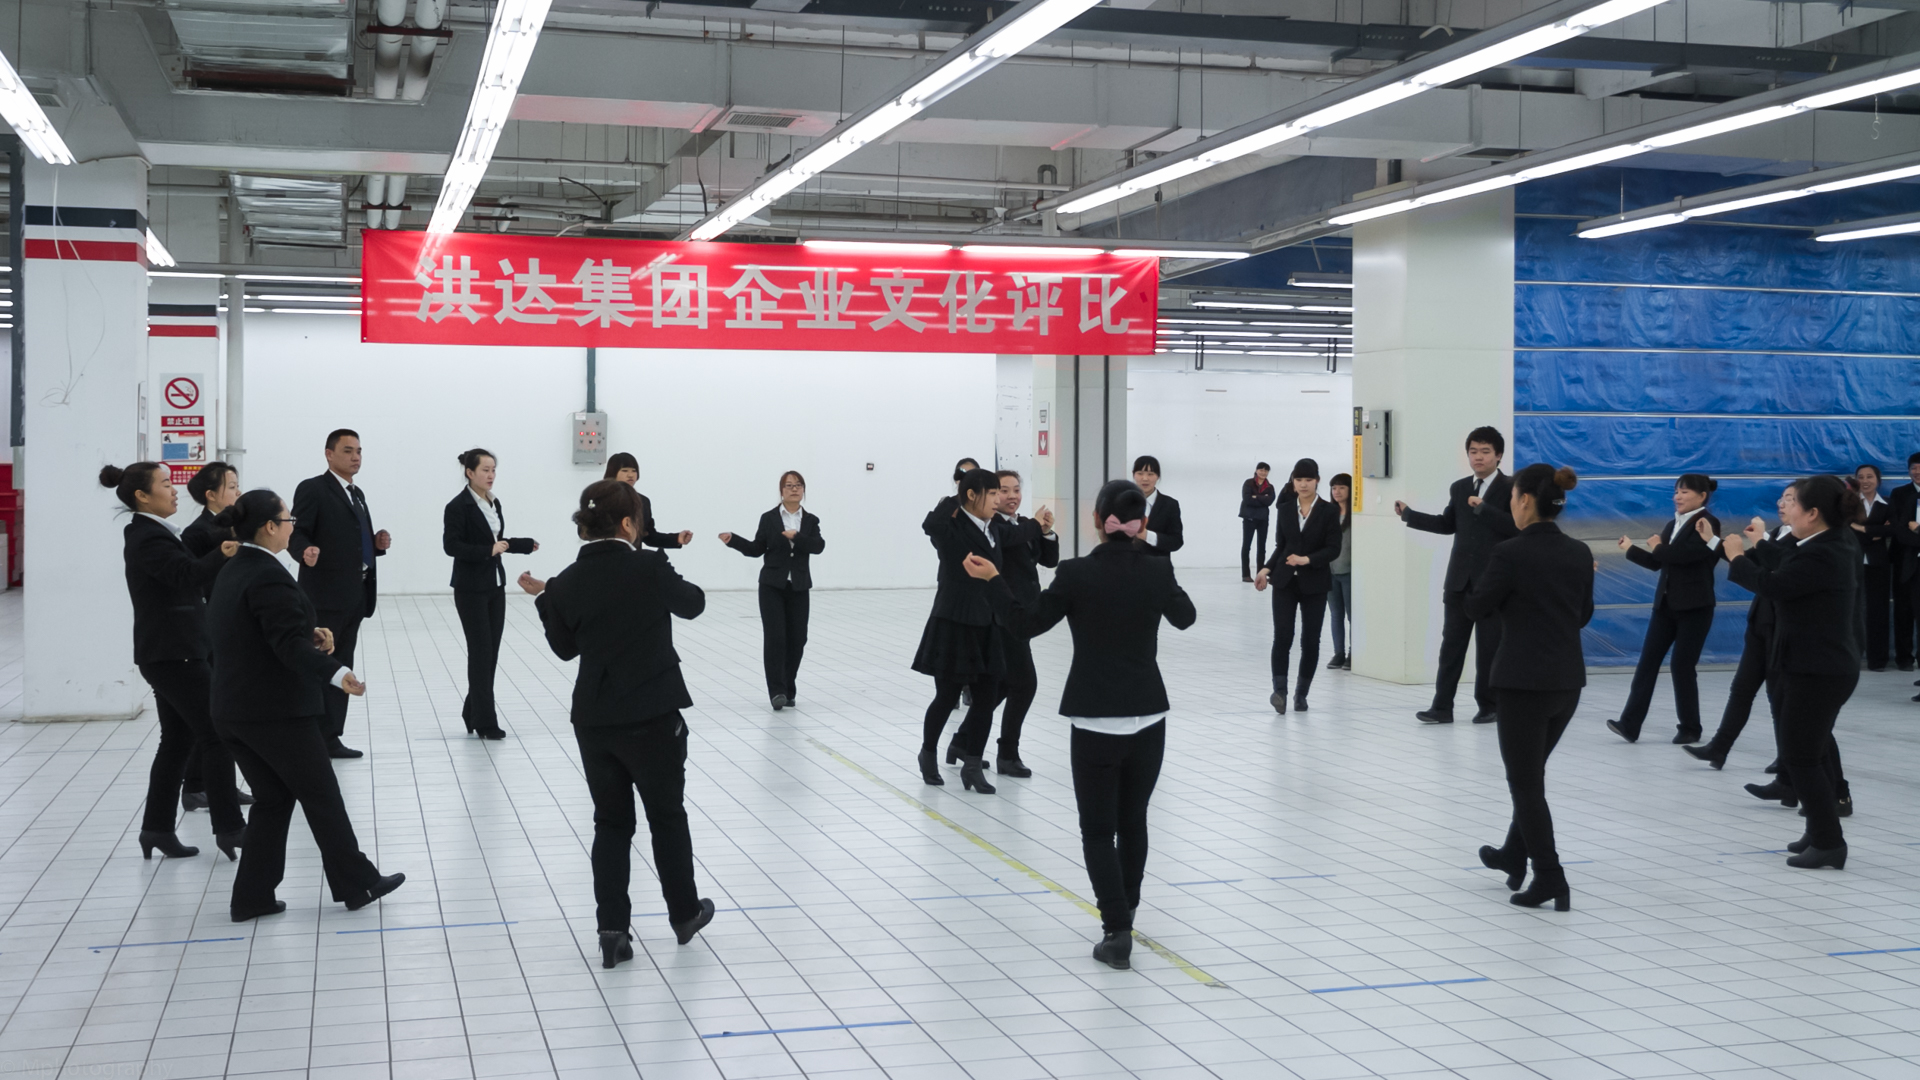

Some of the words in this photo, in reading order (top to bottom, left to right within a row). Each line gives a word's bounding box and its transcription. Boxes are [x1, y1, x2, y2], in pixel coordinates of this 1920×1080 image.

[415, 255, 1130, 336] 洪达集团企业文化评比
[167, 417, 199, 425] 禁止吸烟
